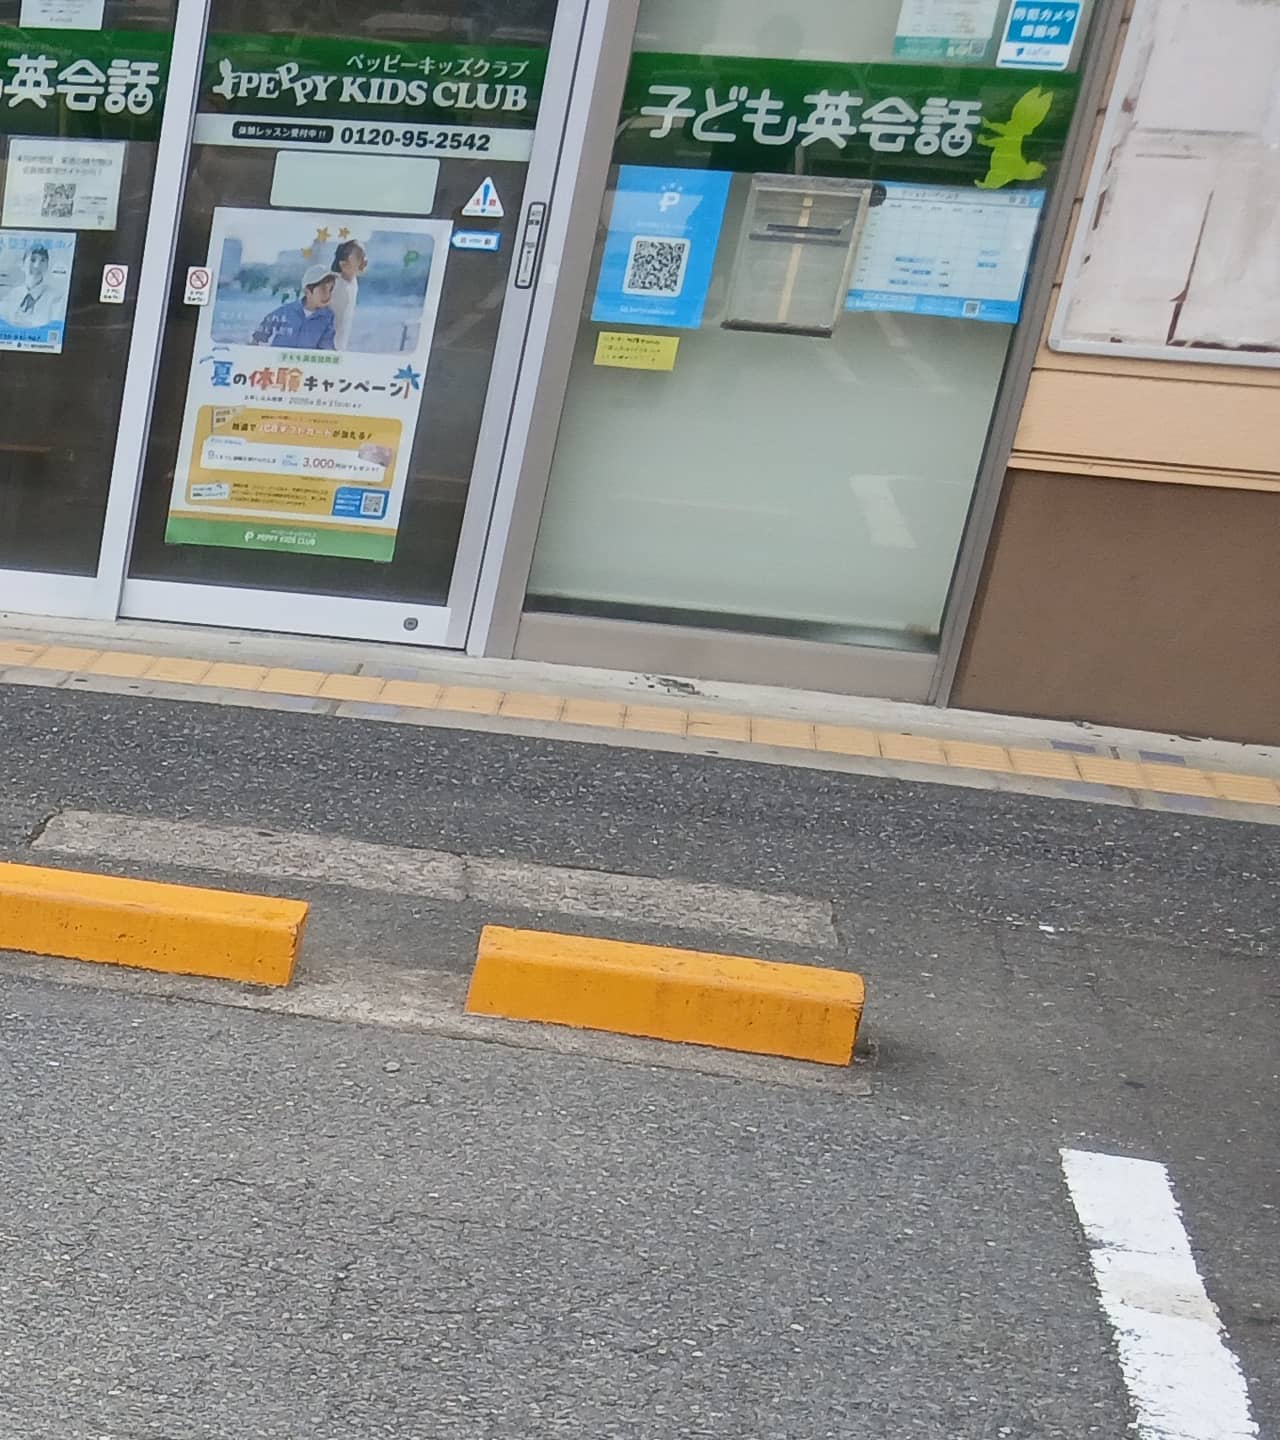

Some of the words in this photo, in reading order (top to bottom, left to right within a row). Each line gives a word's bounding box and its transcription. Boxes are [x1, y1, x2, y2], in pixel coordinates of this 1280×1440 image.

[346, 53, 530, 79] ペッピーキッズクラブ
[237, 61, 338, 106] PEPPY
[339, 77, 428, 105] KIDS
[432, 82, 528, 111] CLUB
[340, 127, 491, 151] 0120-95-2542
[640, 85, 983, 158] 子ども英会話
